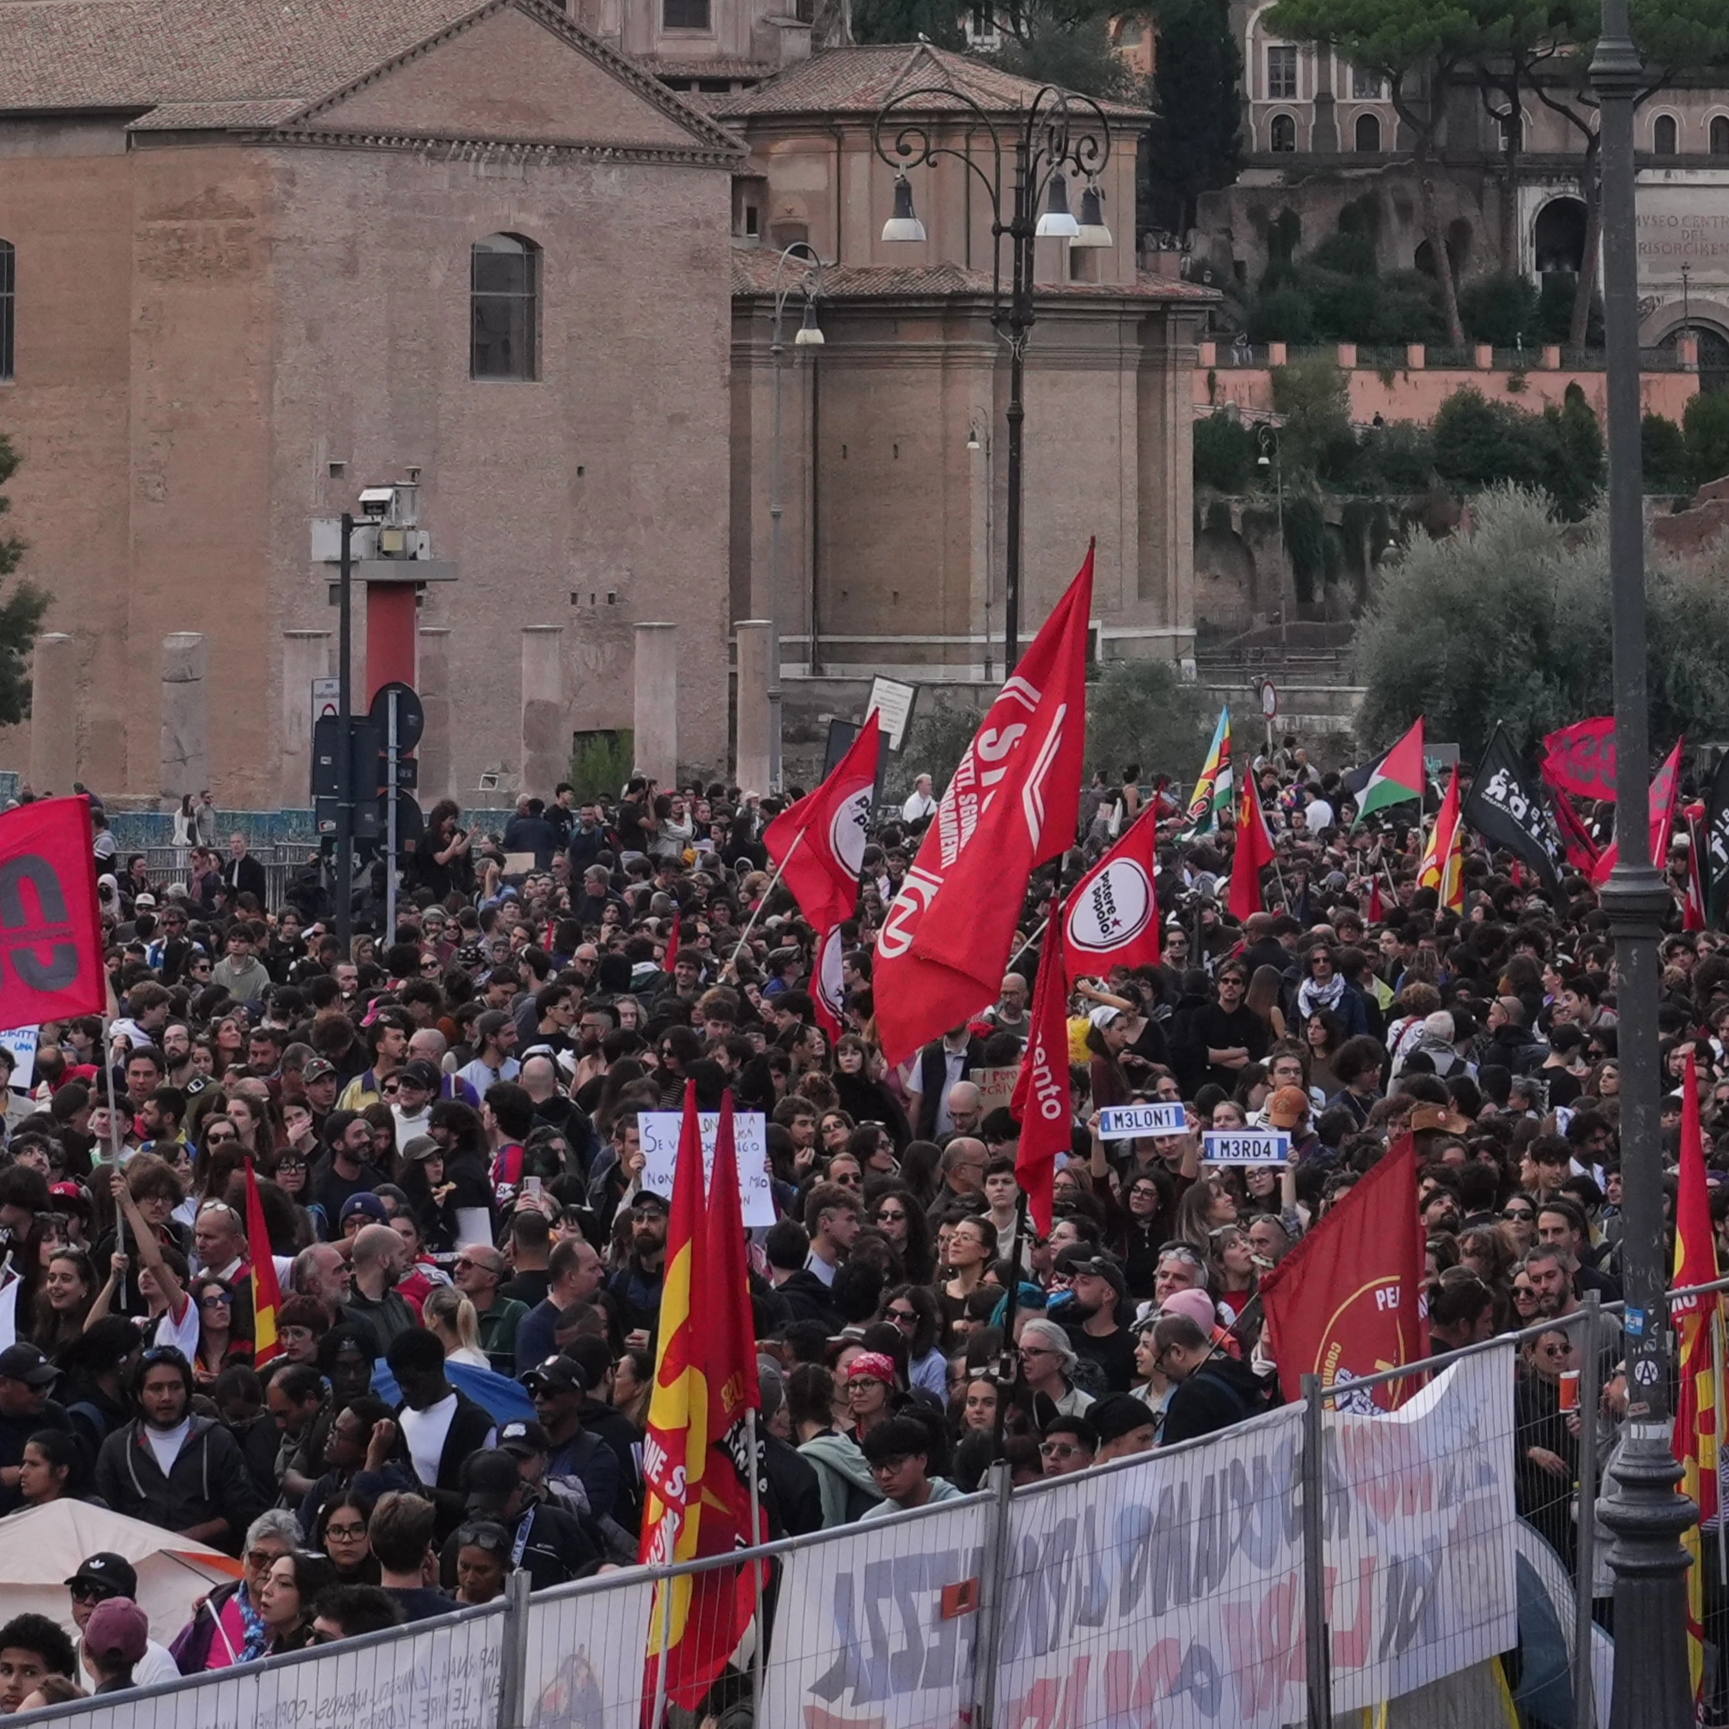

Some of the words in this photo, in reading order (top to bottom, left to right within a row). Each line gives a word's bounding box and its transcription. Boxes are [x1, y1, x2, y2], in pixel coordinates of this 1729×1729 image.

[1100, 870, 1117, 915] potere
[1092, 886, 1115, 939] popolo!
[1033, 1039, 1061, 1120] ento
[1114, 1107, 1172, 1129] M3LON1
[1220, 1138, 1272, 1158] M3RD4
[1375, 1285, 1401, 1311] PE
